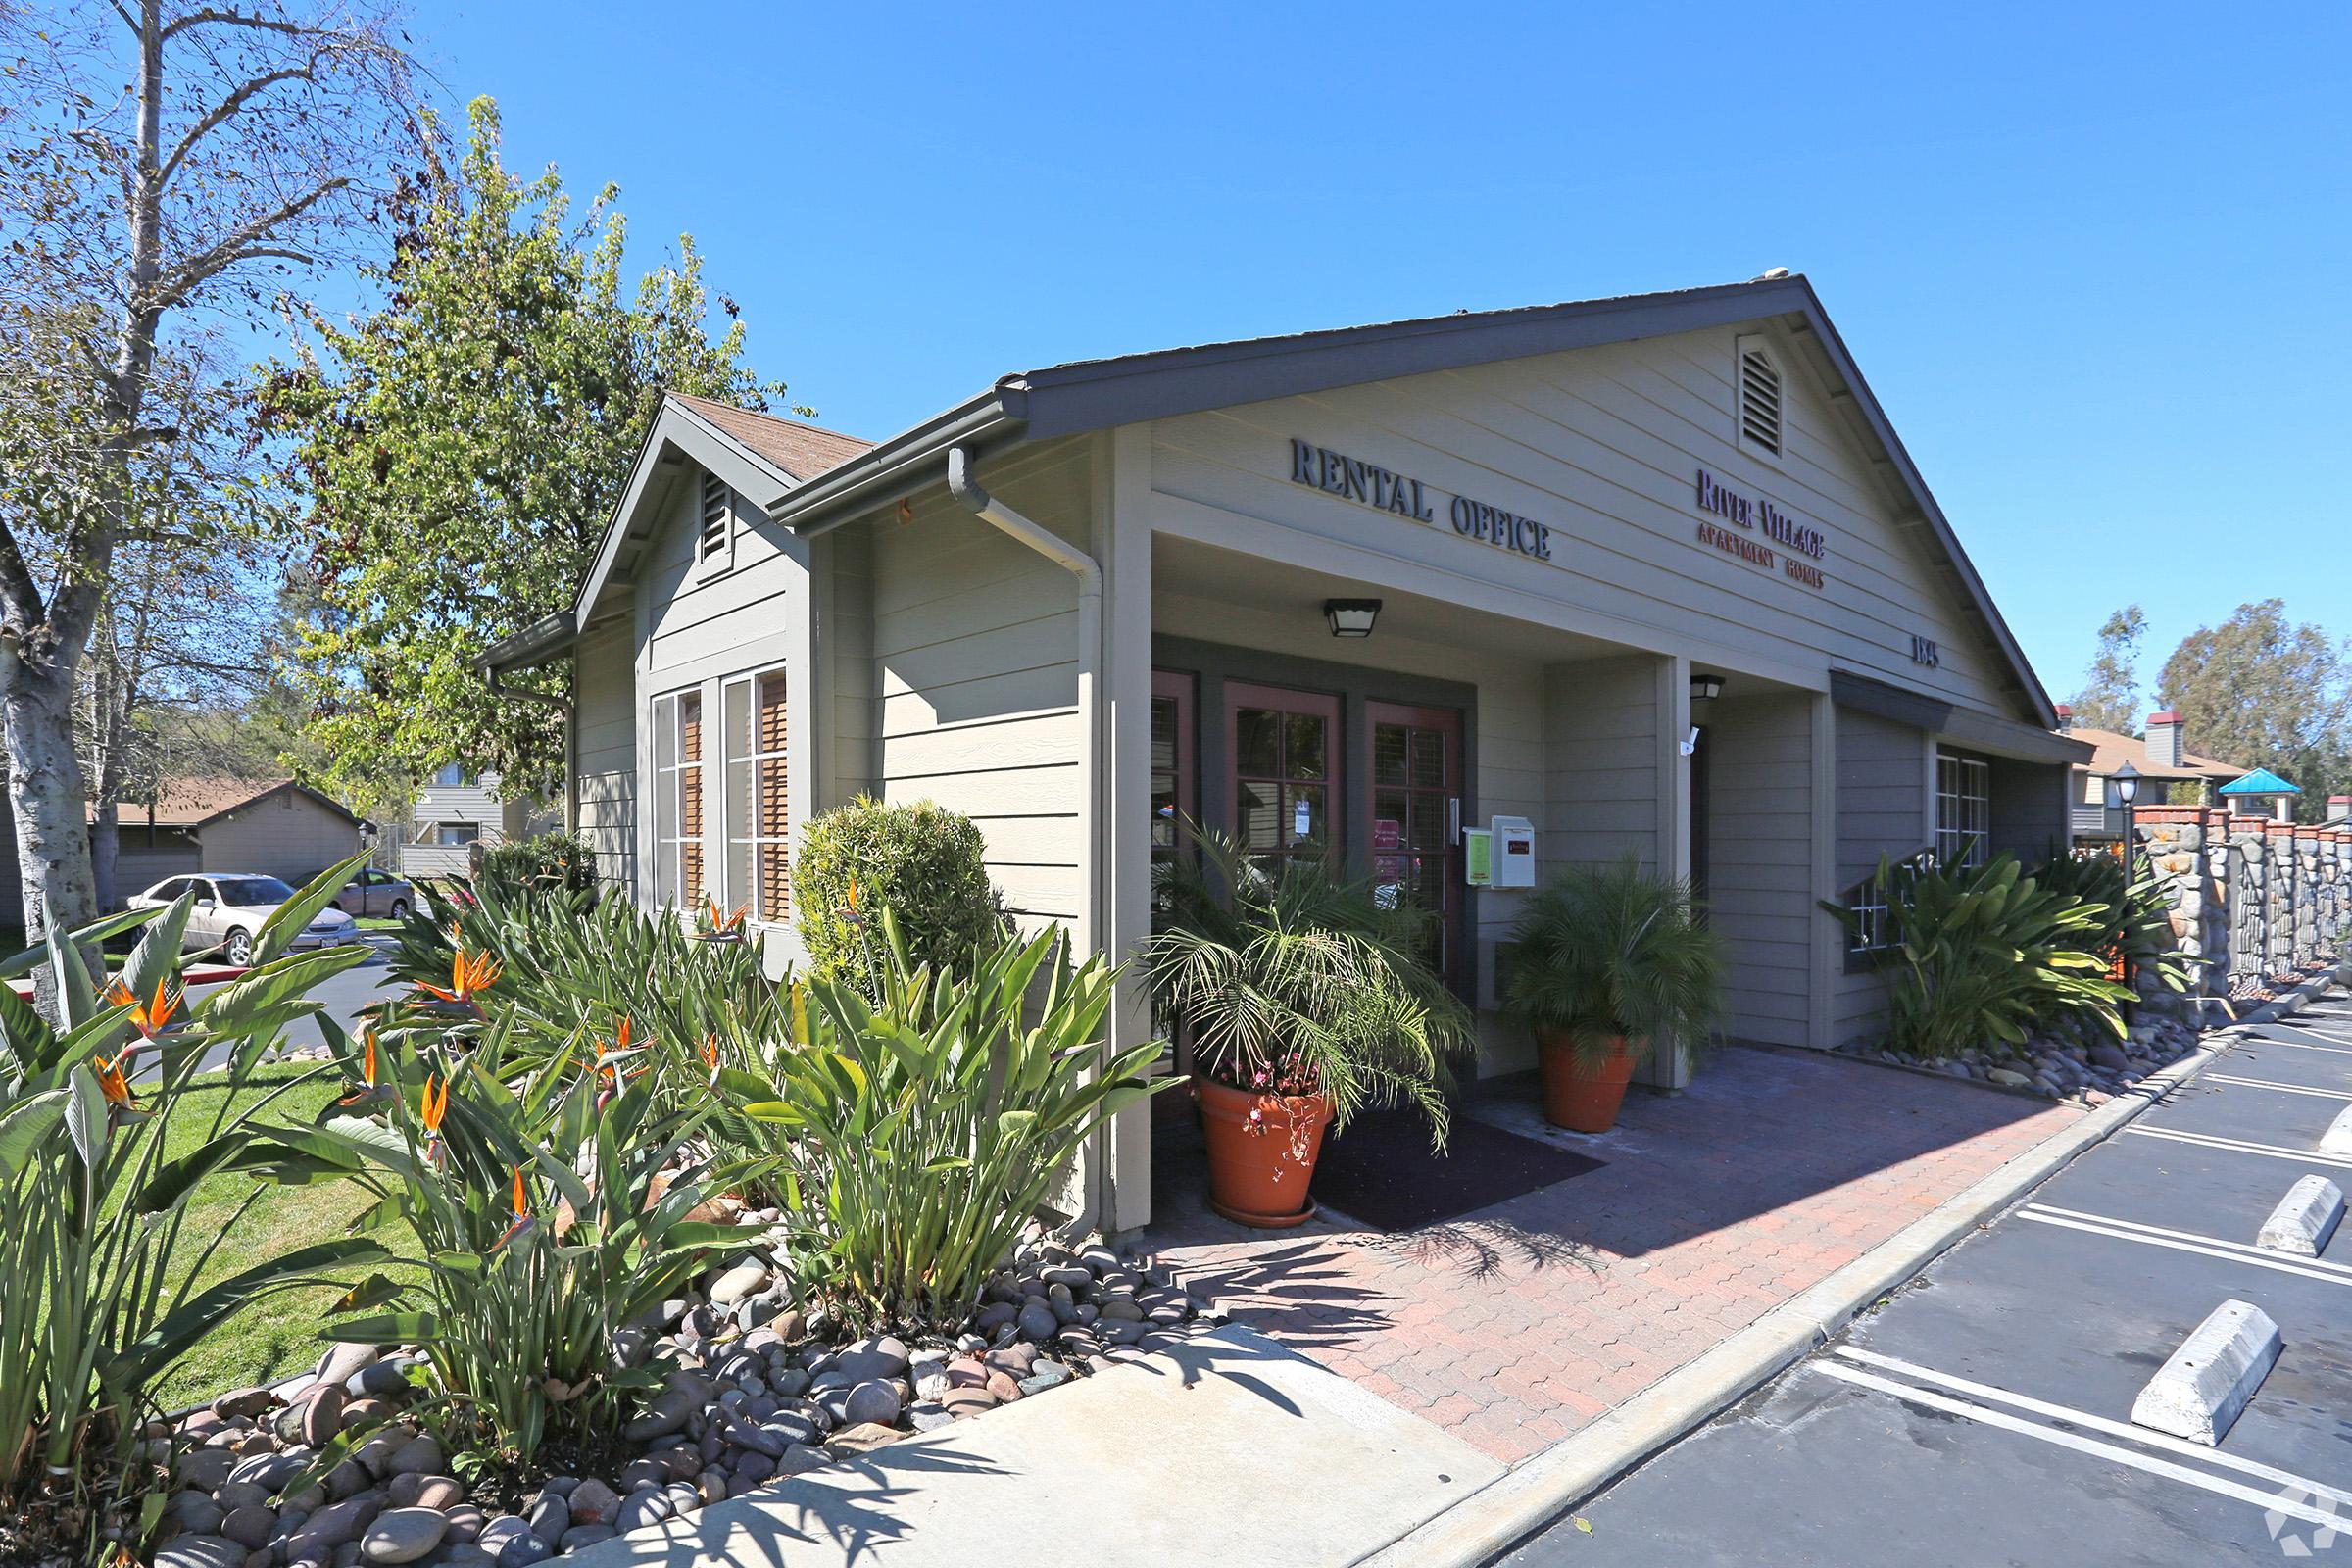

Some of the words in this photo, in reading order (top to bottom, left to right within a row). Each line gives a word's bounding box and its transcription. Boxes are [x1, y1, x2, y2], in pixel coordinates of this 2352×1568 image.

[1291, 438, 1433, 522] RENTAL
[1450, 494, 1551, 561] OFFICE
[1697, 469, 1753, 529] RIVER
[1761, 500, 1825, 560] VILLAGE
[1698, 523, 1775, 569] APARTMENT
[1786, 557, 1825, 590] HOMES
